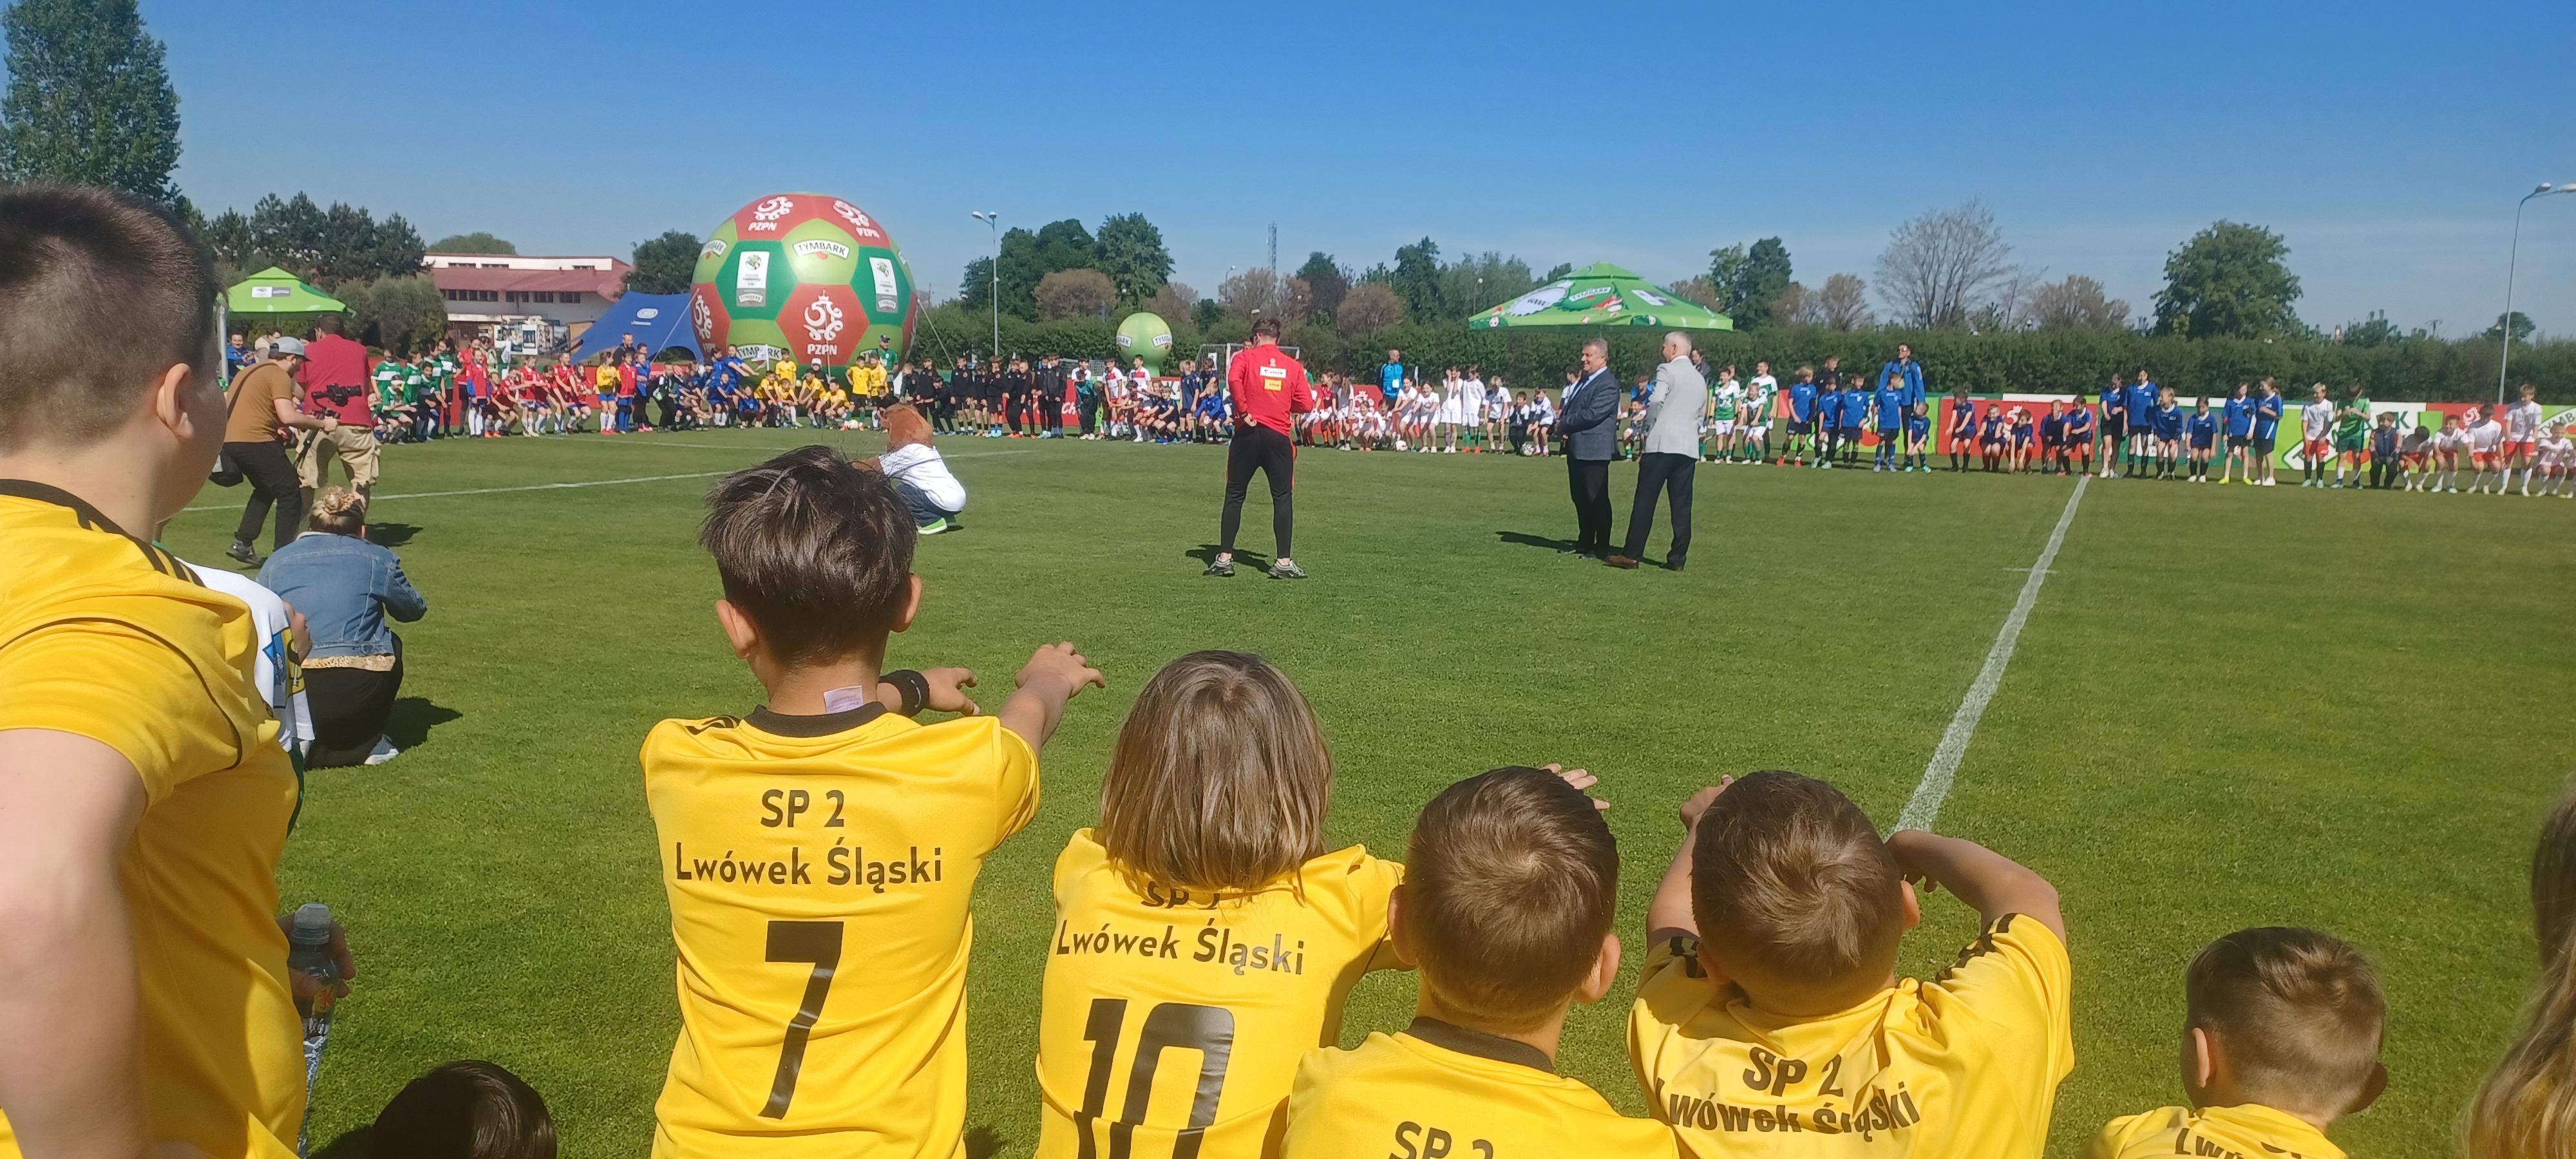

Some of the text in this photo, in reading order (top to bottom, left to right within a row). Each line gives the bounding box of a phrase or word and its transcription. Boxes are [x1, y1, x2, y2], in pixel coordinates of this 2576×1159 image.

[748, 222, 777, 231] PZPN
[797, 242, 846, 256] TYMBARK
[737, 347, 780, 358] TYMBRK
[807, 344, 837, 355] PZPN
[760, 789, 845, 828] SP 2
[676, 836, 942, 894] Lwówek Śląski
[1056, 918, 1304, 976] Lwówek Śląski
[757, 920, 844, 1120] 7
[1072, 998, 1235, 1159] 10
[1742, 1046, 1844, 1097] SP 2
[1387, 1120, 1452, 1159] SP
